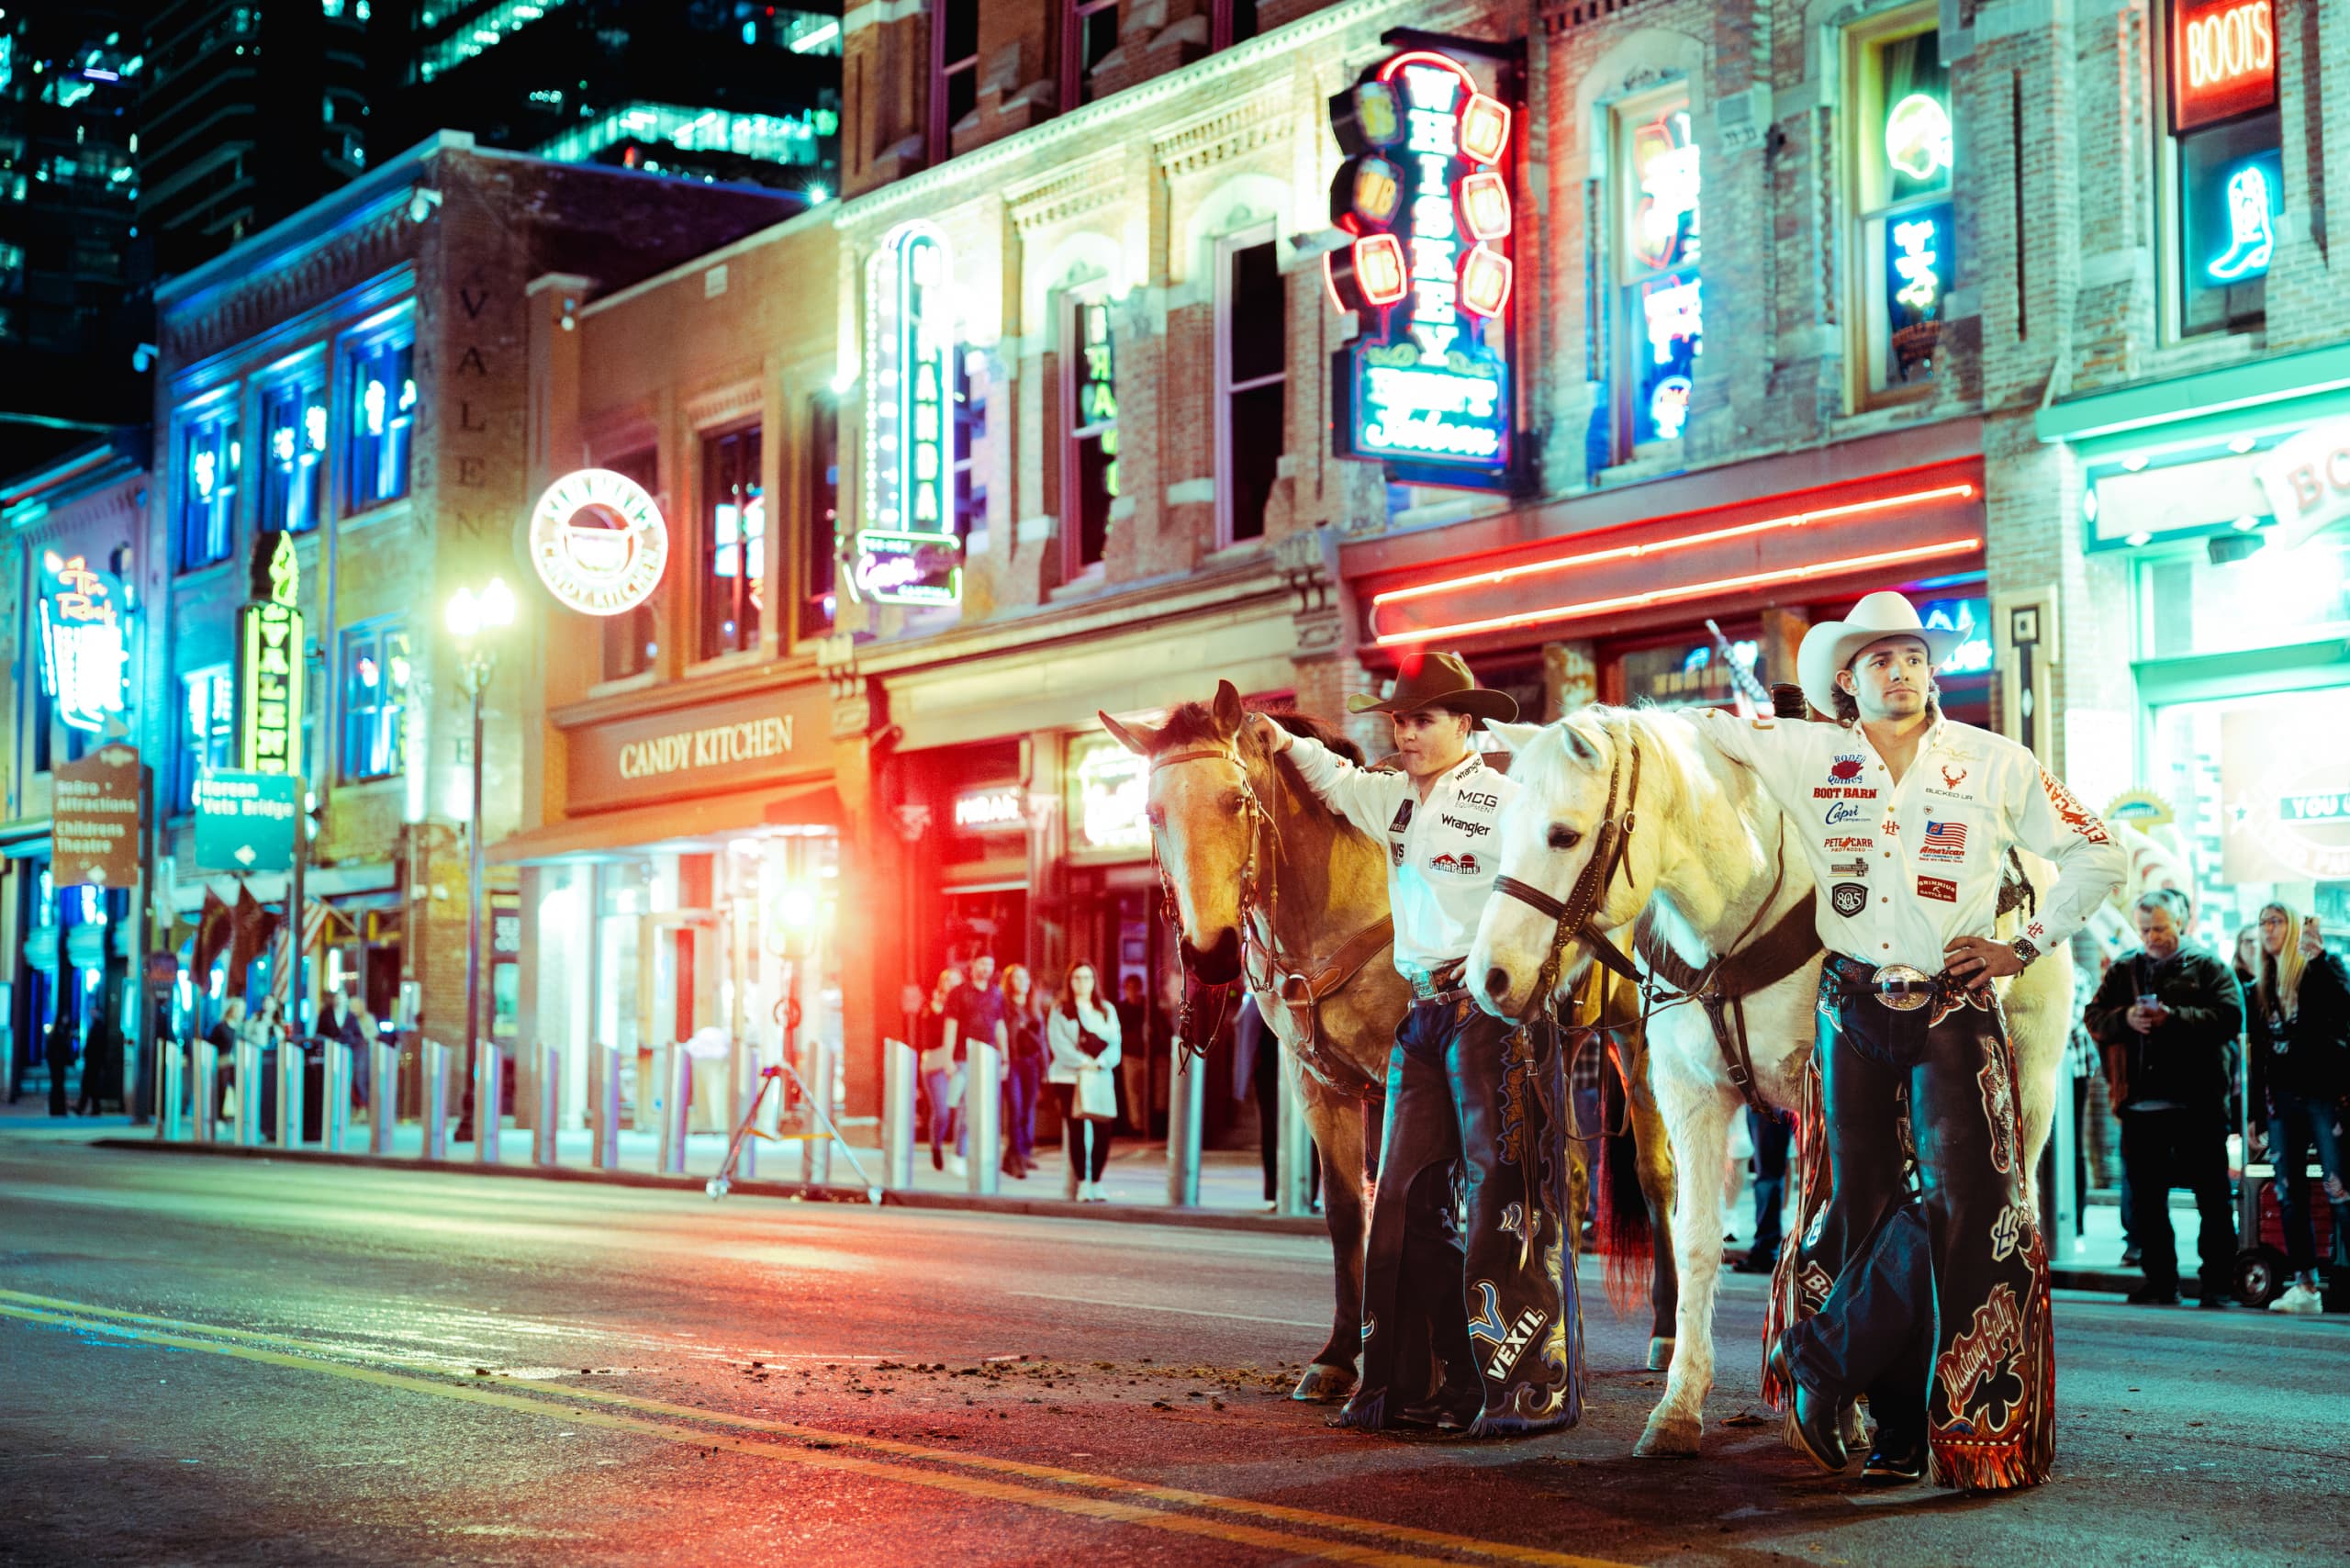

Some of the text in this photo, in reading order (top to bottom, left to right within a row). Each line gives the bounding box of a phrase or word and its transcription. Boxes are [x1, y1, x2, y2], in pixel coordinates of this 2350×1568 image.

[2188, 1, 2271, 87] BOOTS
[1404, 65, 1461, 366] WHISKEY
[453, 286, 490, 765] VALENNE
[618, 714, 794, 779] CANDY KITCHEN
[1457, 789, 1498, 808] MCG
[1812, 787, 1878, 800] BOOT BARN
[1925, 788, 1960, 799] BUCKED
[241, 797, 296, 822] Bridge
[1825, 801, 1860, 825] Capri
[2291, 795, 2339, 819] YOU
[56, 820, 126, 838] Childrens
[1441, 812, 1491, 838] Wrangler
[57, 836, 112, 854] Theatre
[1823, 837, 1874, 848] PETE CARR
[1919, 845, 1965, 857] American
[1836, 891, 1862, 907] 805
[1982, 1299, 2015, 1351] Sally
[1487, 1311, 1543, 1380] VEXIL
